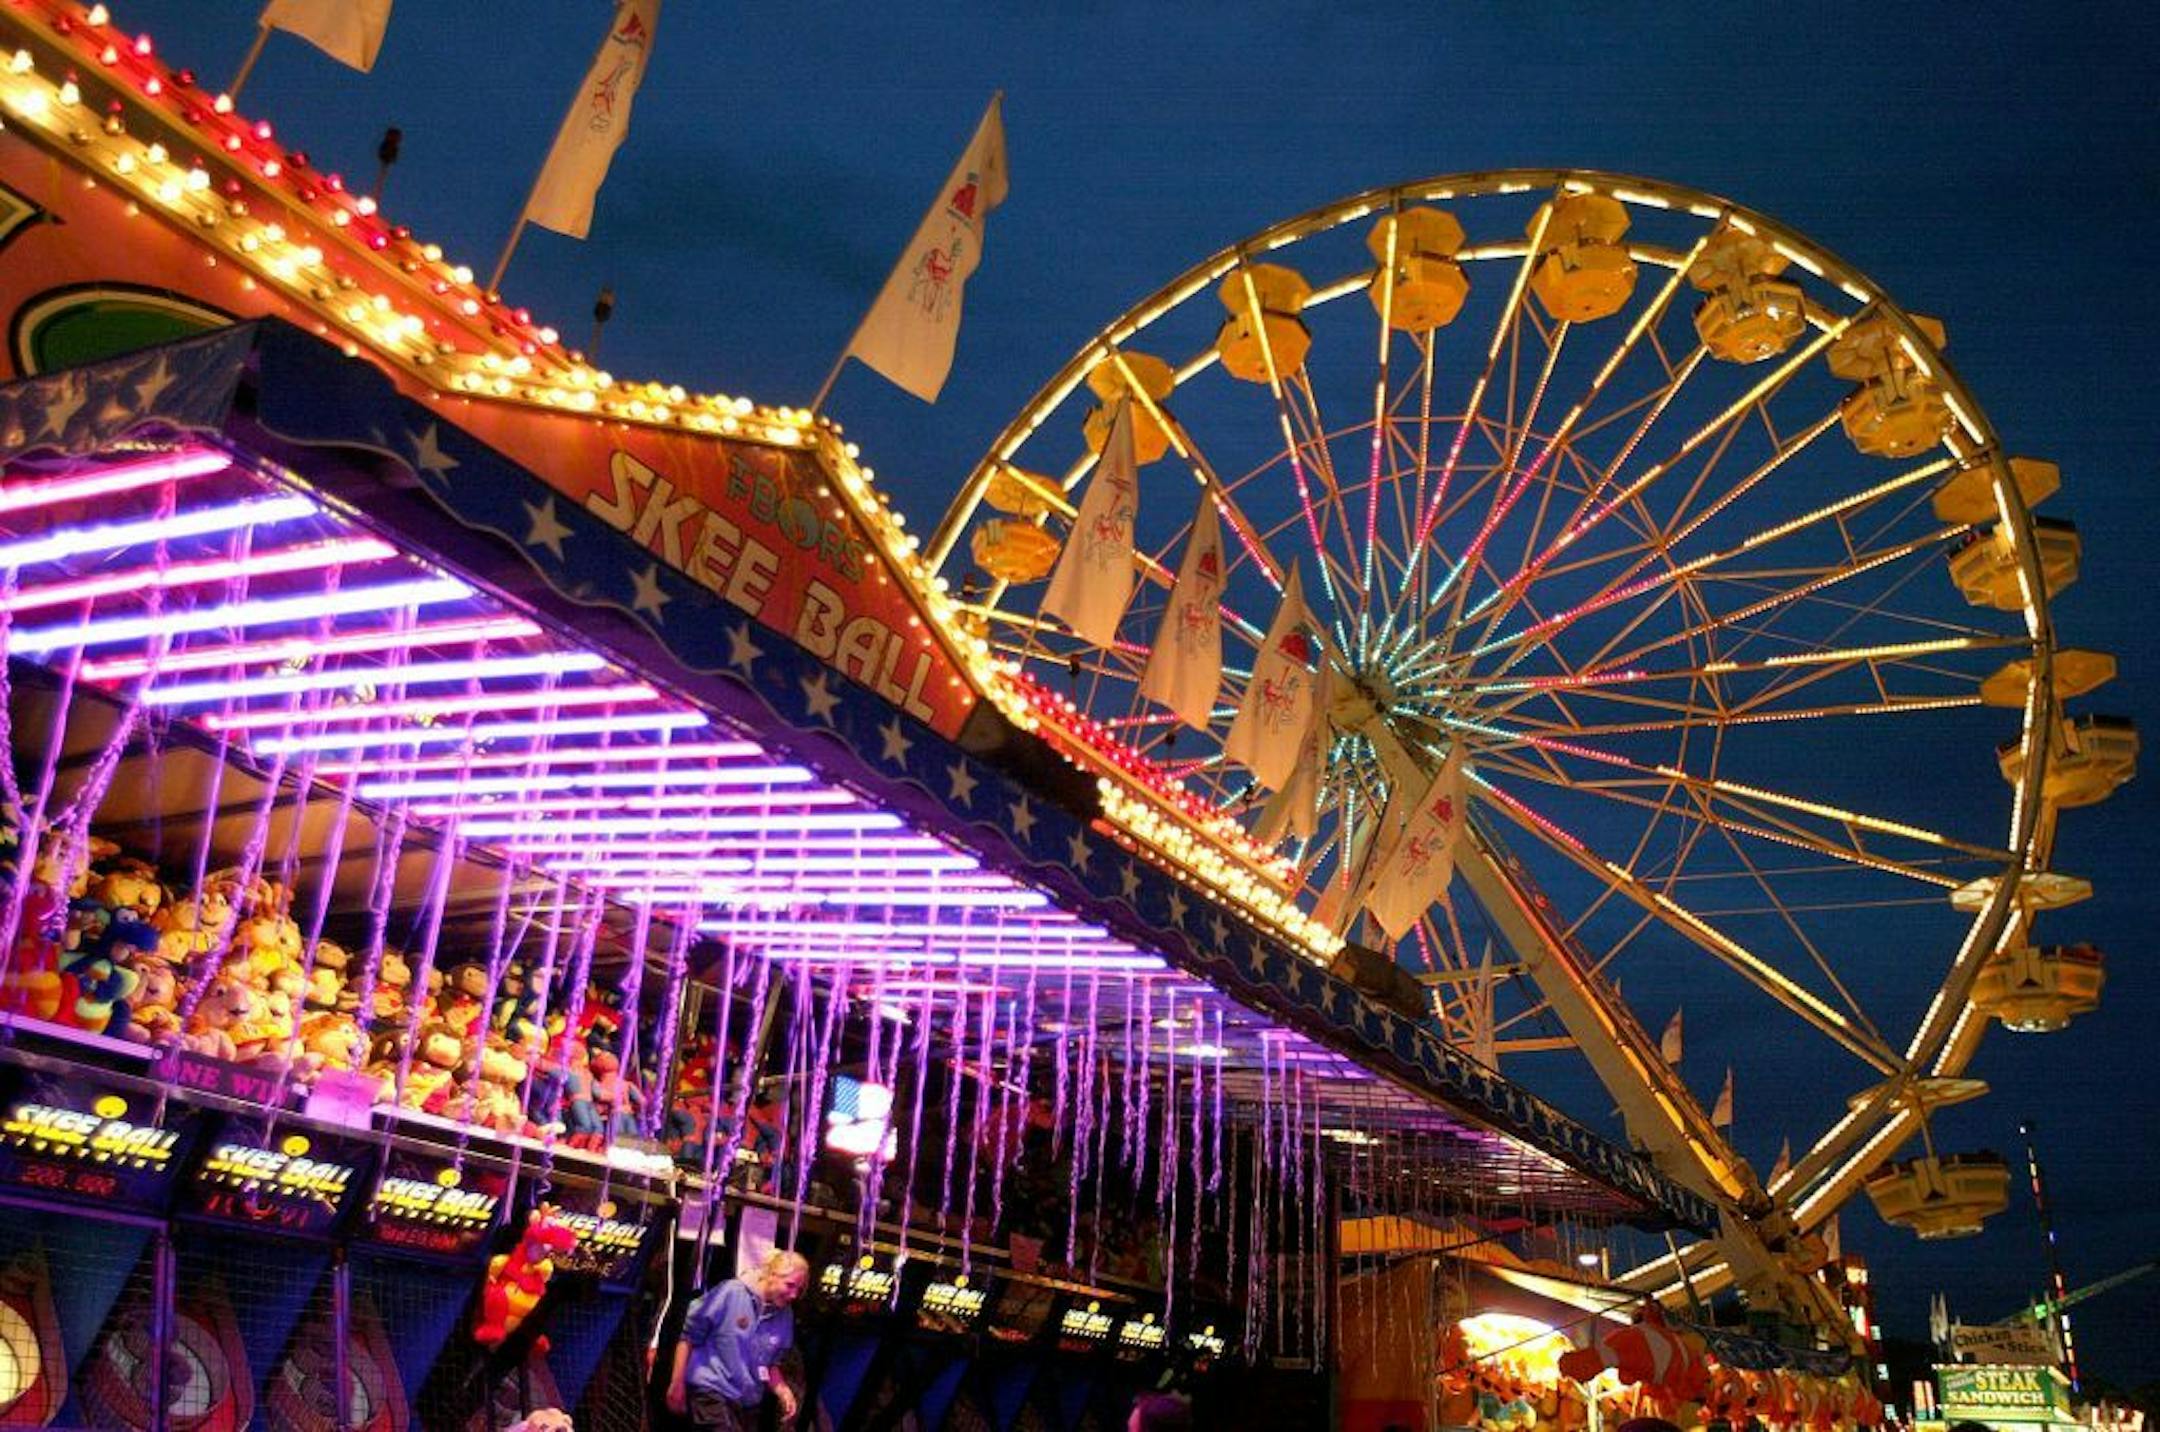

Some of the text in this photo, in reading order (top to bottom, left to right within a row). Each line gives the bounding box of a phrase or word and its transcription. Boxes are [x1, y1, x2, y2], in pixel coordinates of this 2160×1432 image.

[585, 451, 934, 723] SKEE BALL
[1975, 1370, 2042, 1391] STEAK
[1947, 1391, 2045, 1405] SANDWICH
